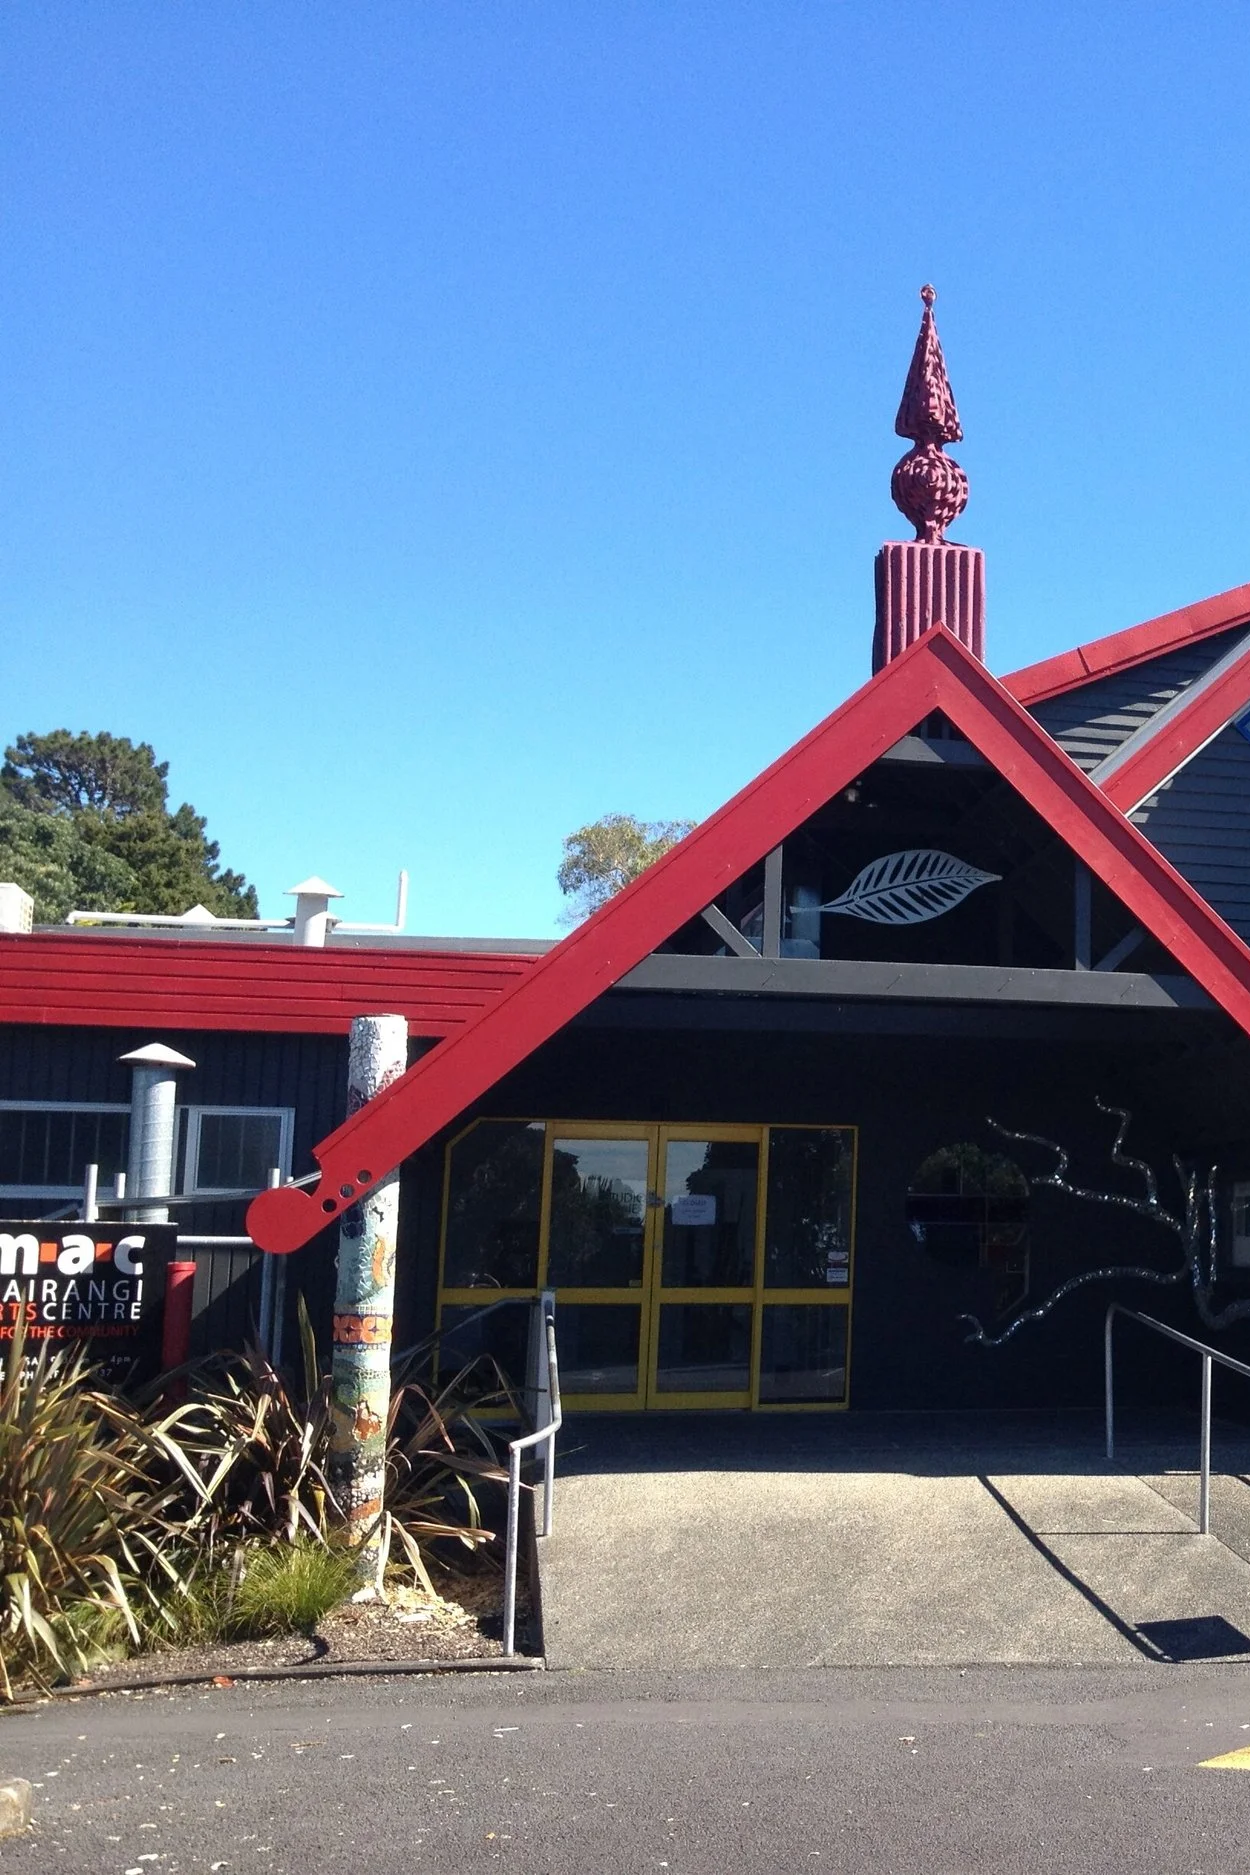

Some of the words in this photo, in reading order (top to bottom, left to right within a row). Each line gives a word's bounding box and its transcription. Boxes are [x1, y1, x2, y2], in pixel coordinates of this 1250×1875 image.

[42, 1302, 142, 1320] CENTRE
[29, 1326, 55, 1338] THE
[57, 1325, 139, 1338] COMMUNITY
